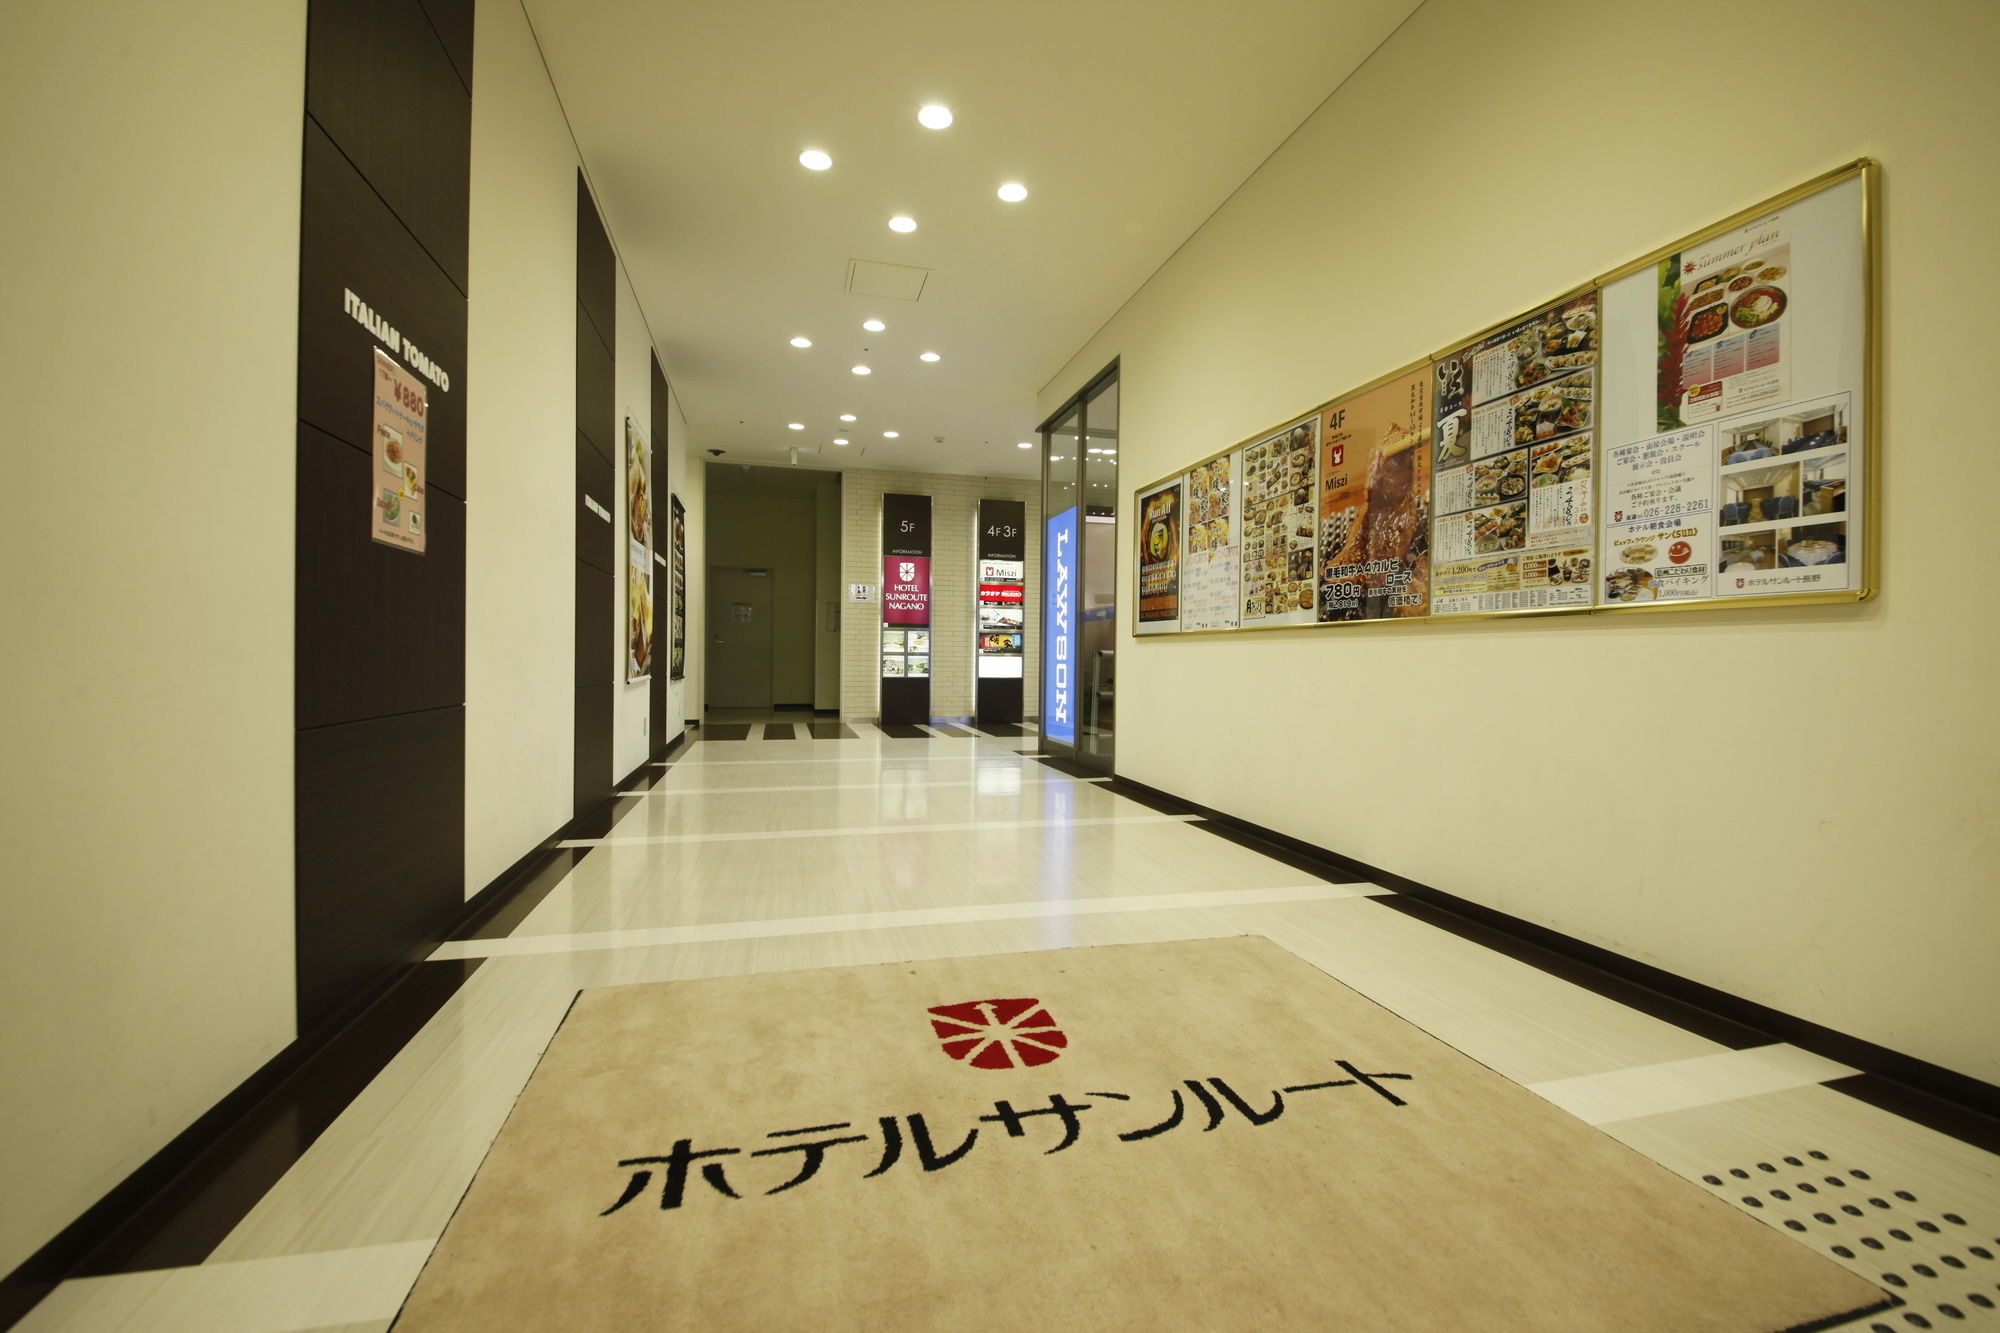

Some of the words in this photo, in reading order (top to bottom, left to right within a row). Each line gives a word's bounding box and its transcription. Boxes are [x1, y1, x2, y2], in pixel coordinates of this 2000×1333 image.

[1698, 244, 1745, 270] summer
[1745, 231, 1780, 256] plan
[344, 287, 400, 354] ITALIAN
[402, 337, 449, 392] TOMATO
[394, 378, 424, 417] ¥880
[1330, 409, 1346, 430] 4F
[1437, 408, 1467, 462] 夏
[1325, 473, 1348, 492] Miszi
[1644, 499, 1709, 518] 026-228-2261
[900, 520, 915, 533] 5F
[987, 525, 1001, 537] 4F
[1003, 525, 1017, 538] 3F
[996, 569, 1017, 577] Miszi
[1325, 557, 1400, 580] 黒毛和牛A4カルビ
[1386, 570, 1412, 586] ロース
[894, 584, 919, 592] HOTEL
[1748, 574, 1821, 586] ホテルサンルート長野
[885, 593, 928, 602] SUNROUTE
[1326, 582, 1360, 600] 780円
[888, 602, 925, 611] NAGANO
[1056, 528, 1069, 723] LAWSON
[601, 1060, 1412, 1216] ホテルサンルート
